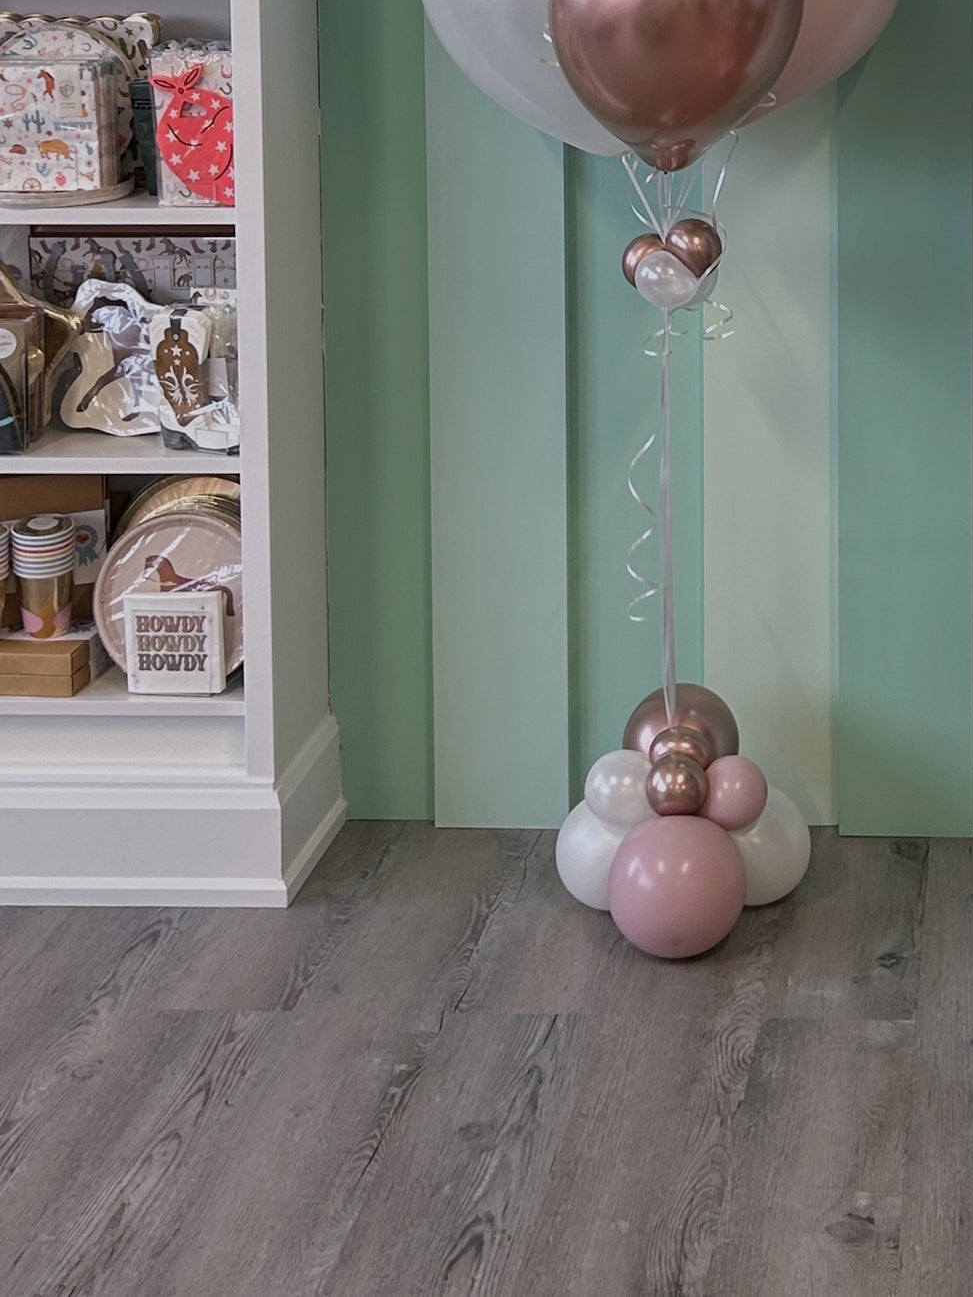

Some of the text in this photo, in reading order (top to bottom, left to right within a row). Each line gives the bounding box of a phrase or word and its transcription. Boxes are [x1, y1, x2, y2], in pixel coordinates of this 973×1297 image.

[135, 615, 207, 633] HOWDY
[136, 634, 208, 652] HOWDY
[137, 653, 208, 672] HOWDY
